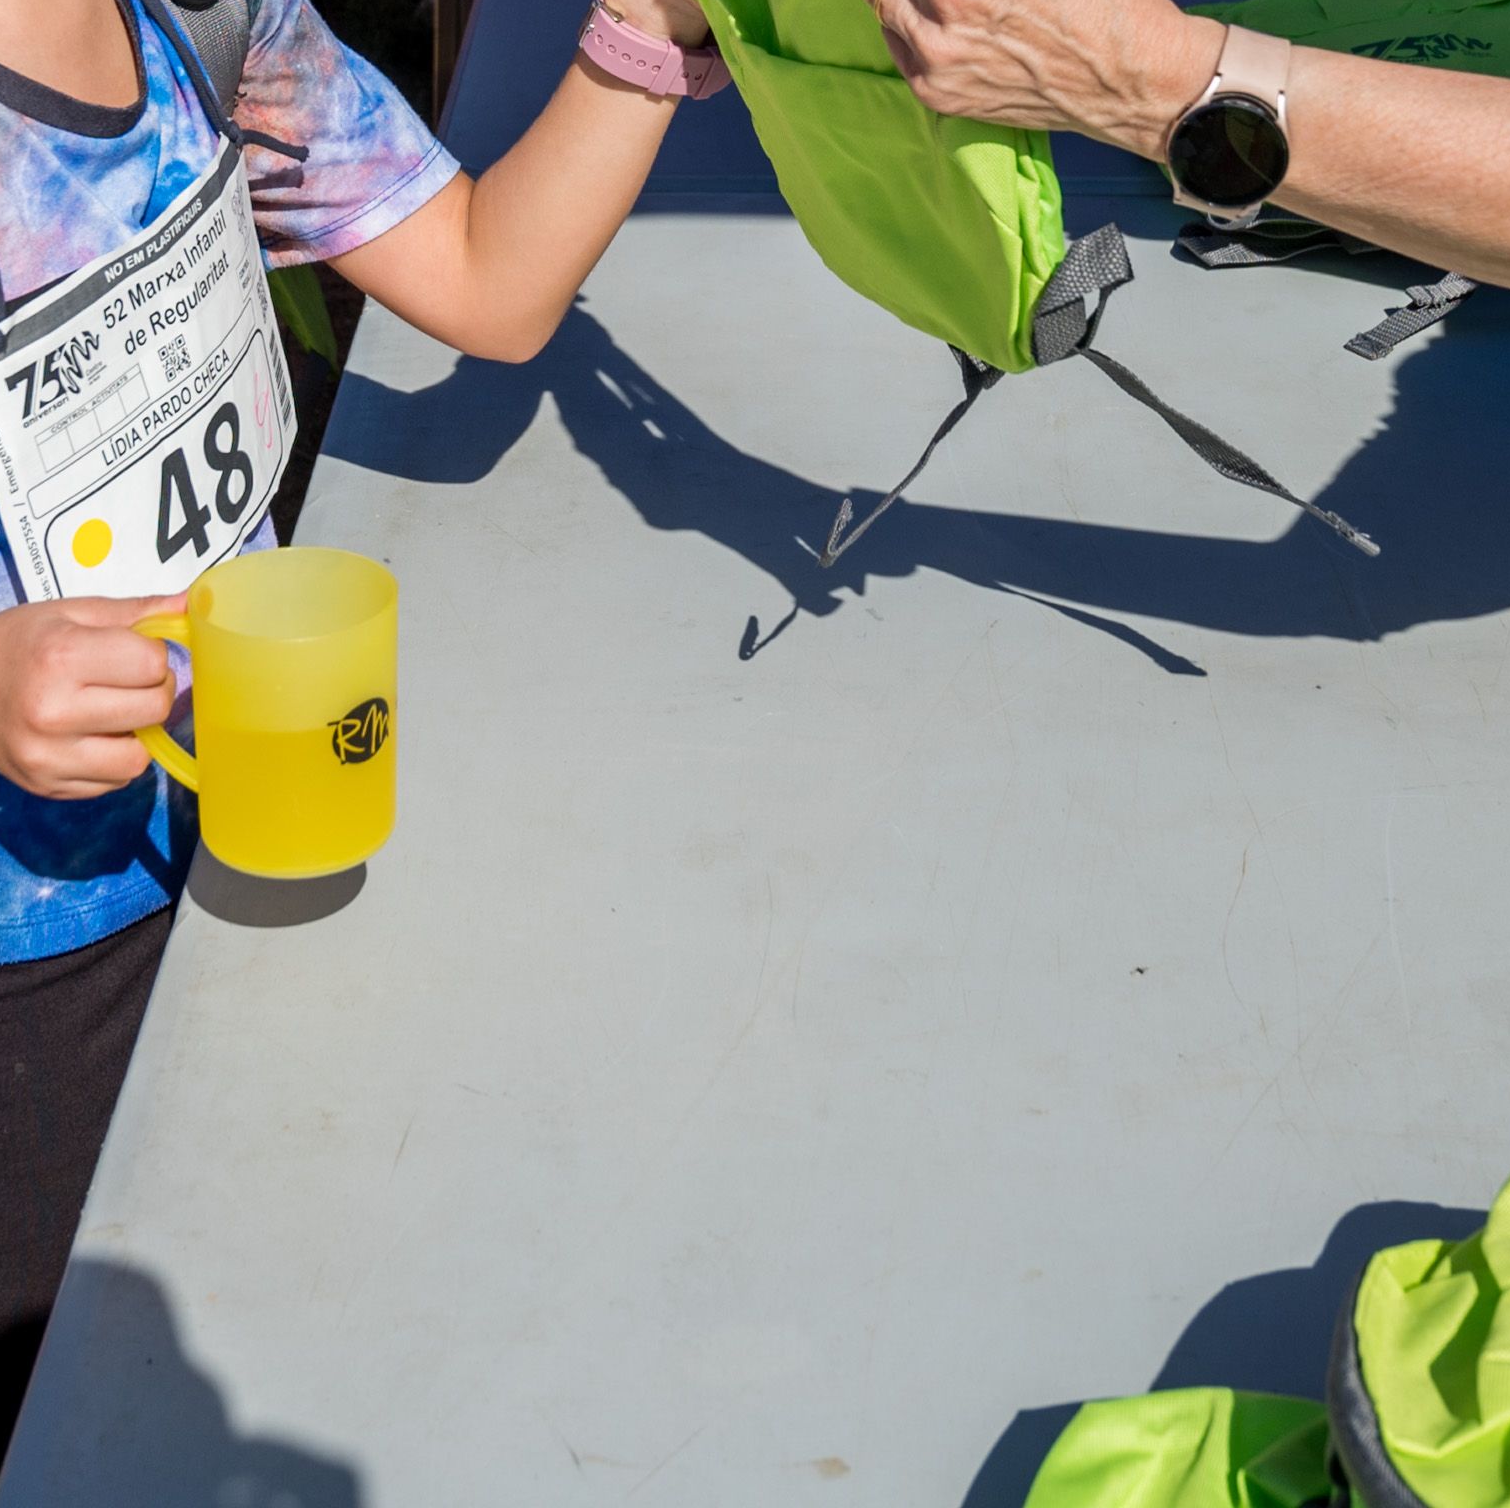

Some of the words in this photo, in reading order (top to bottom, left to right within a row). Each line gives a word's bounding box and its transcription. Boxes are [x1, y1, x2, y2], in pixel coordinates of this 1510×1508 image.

[103, 298, 128, 329] 52
[127, 260, 187, 311] Marxa
[183, 209, 227, 268] Infantil
[104, 262, 124, 283] NO
[124, 249, 145, 270] EM
[146, 198, 203, 258] PLASTIFIQUIS
[124, 329, 147, 355] de
[149, 249, 230, 336] Regularitat
[4, 342, 69, 420] 75
[50, 405, 89, 434] CONTROL
[91, 375, 129, 406] ACTIVITATS
[101, 427, 143, 466] LÍDIA
[142, 386, 192, 436] PARDO
[193, 348, 230, 394] CHECA
[156, 401, 254, 564] 48
[19, 515, 46, 576] 693057554
